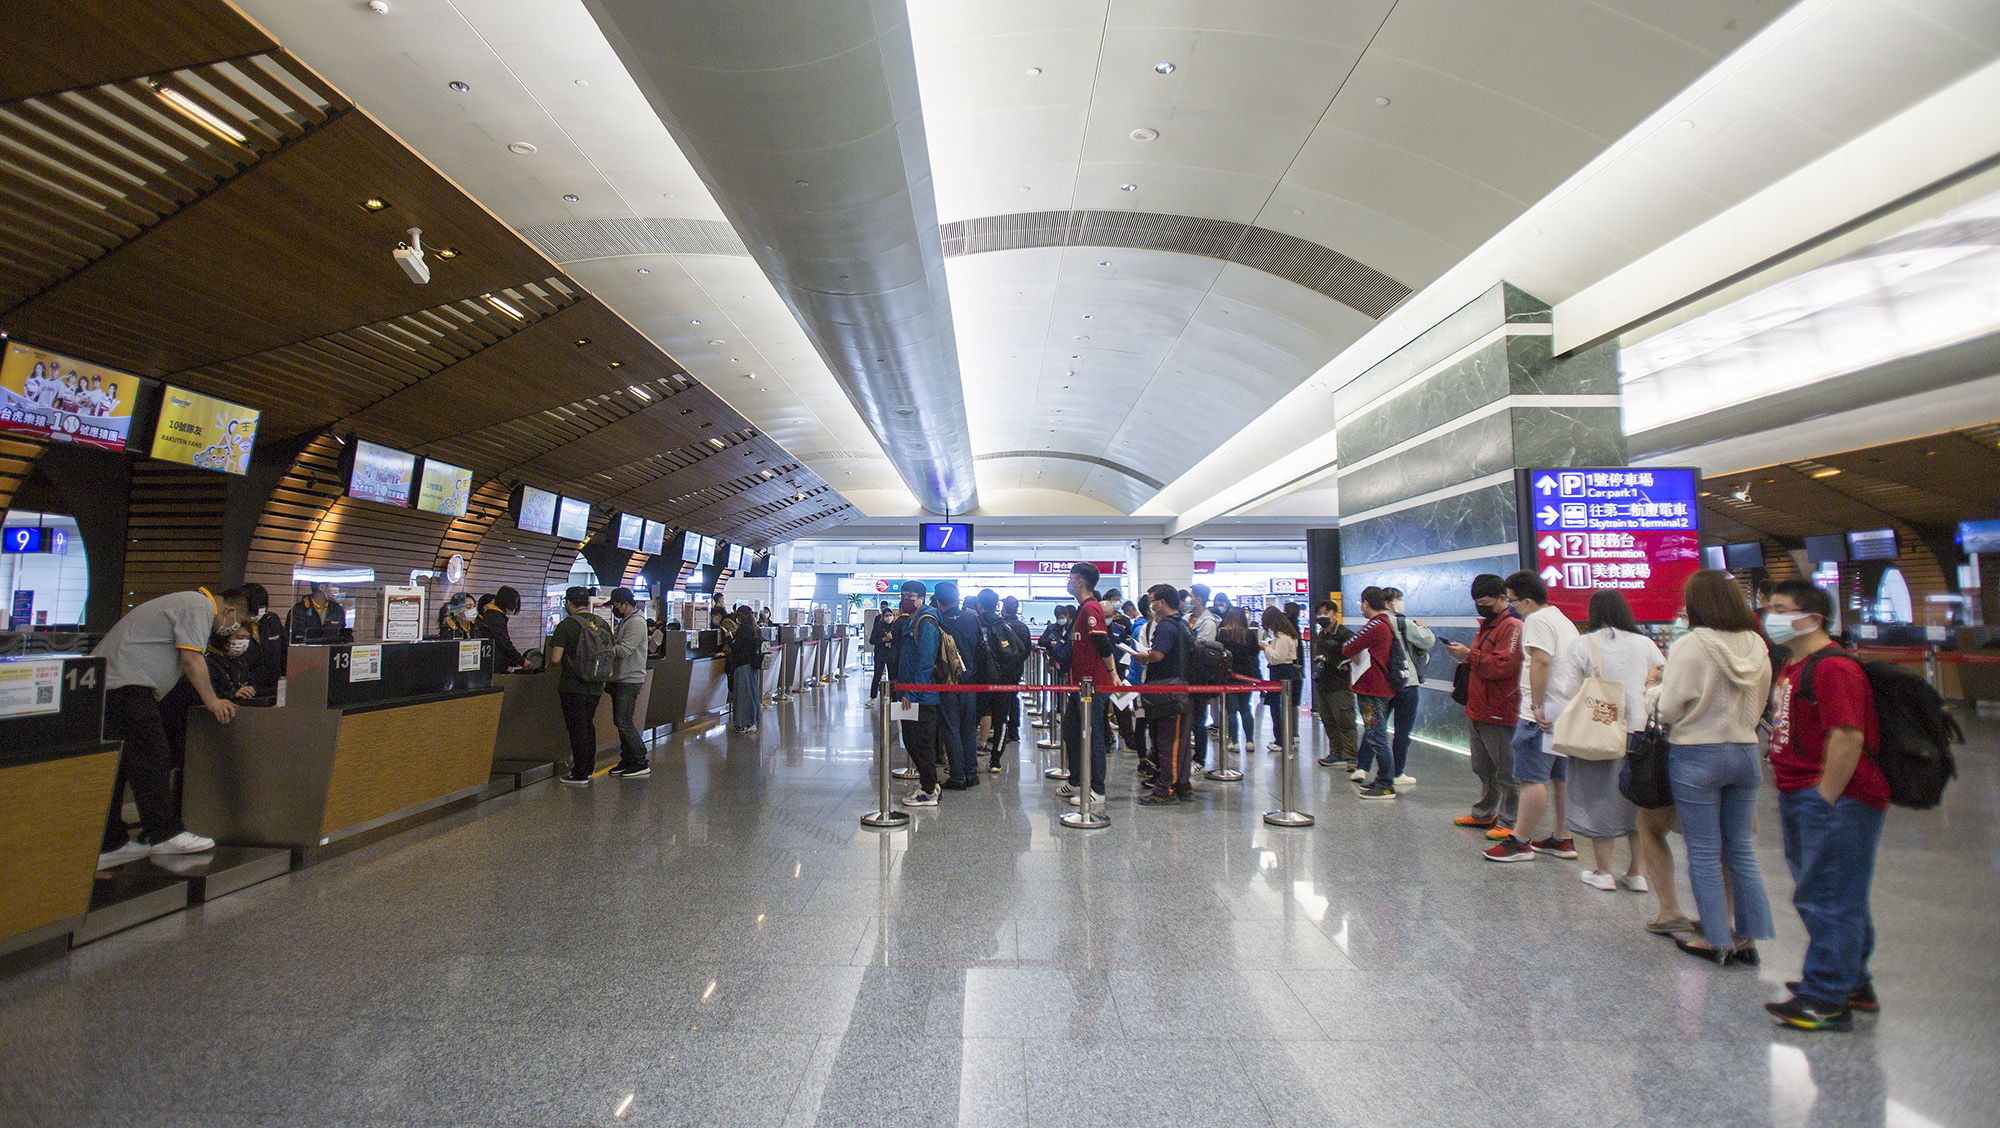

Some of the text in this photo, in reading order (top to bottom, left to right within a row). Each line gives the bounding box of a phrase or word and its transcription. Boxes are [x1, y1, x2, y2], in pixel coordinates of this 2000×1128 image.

[169, 420, 203, 436] 10號隊友
[161, 434, 202, 449] RAKUTEN FANS
[1586, 473, 1654, 487] 1號停車場
[1588, 488, 1638, 499] Car park 1
[1589, 503, 1688, 517] 往第二航廈電車
[1589, 519, 1689, 530] Skytrain to Terminal 2
[17, 530, 30, 551] 9
[939, 526, 953, 549] 7
[1590, 533, 1635, 548] 服務台
[1590, 549, 1646, 558] Information
[1592, 563, 1651, 579] 美食廣場
[1592, 580, 1646, 589] Food court
[481, 645, 492, 658] 12
[333, 652, 350, 669] 13
[65, 667, 97, 691] 14
[1780, 684, 1793, 744] MONKEYS
